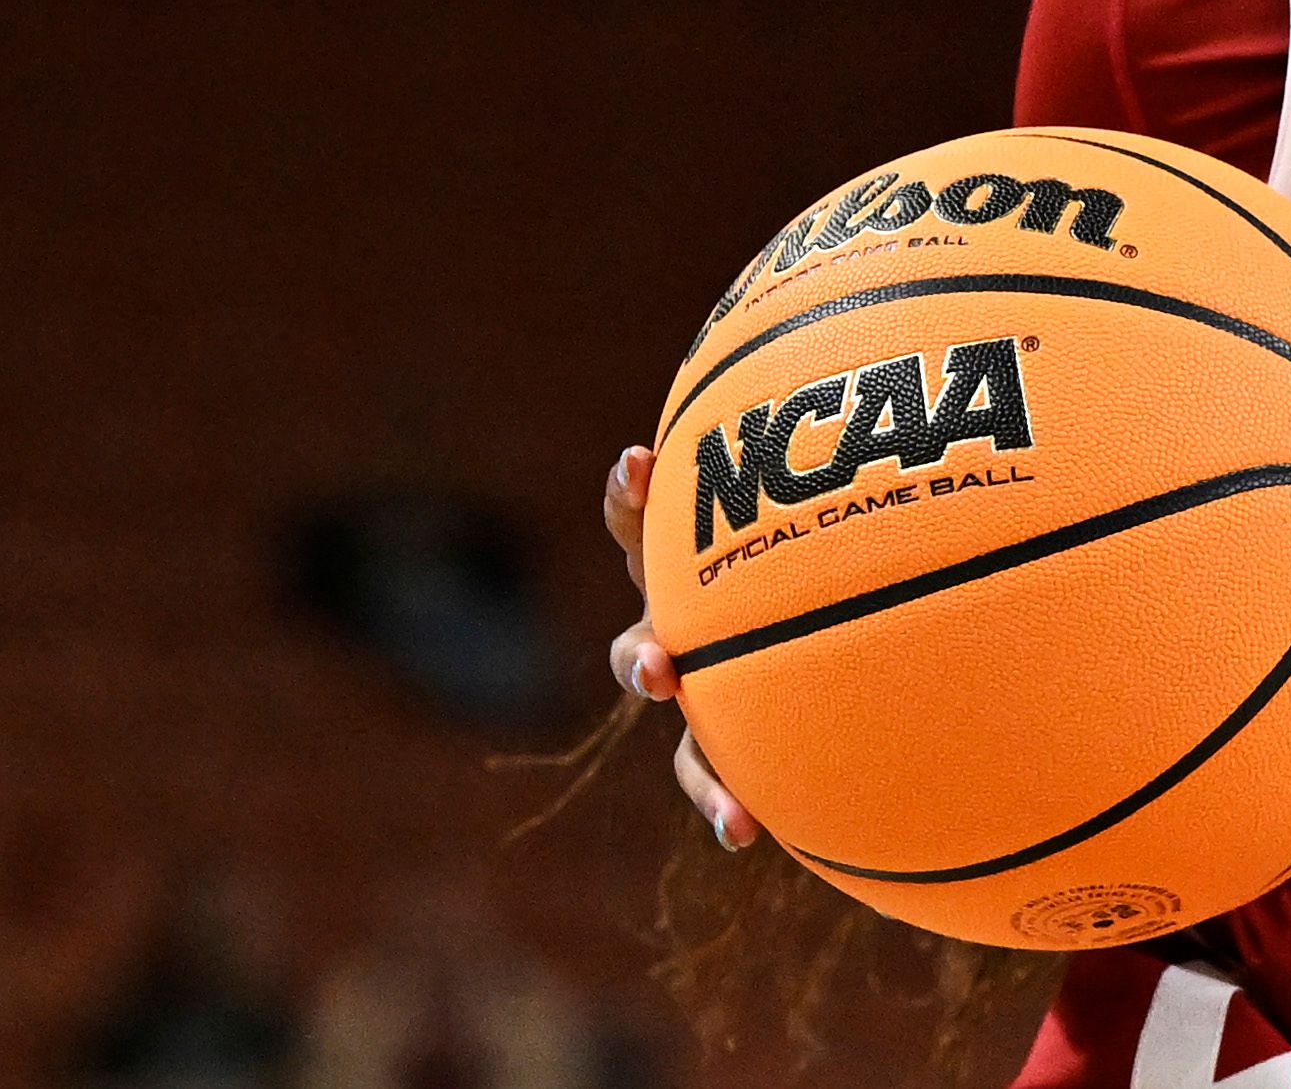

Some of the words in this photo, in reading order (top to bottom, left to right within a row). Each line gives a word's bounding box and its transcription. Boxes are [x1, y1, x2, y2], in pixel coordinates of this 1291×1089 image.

[907, 235, 969, 248] BALL
[694, 335, 1034, 554] NCAA
[698, 521, 811, 588] OFFICIAL
[816, 484, 919, 528] GAME
[929, 465, 1035, 498] BALL
